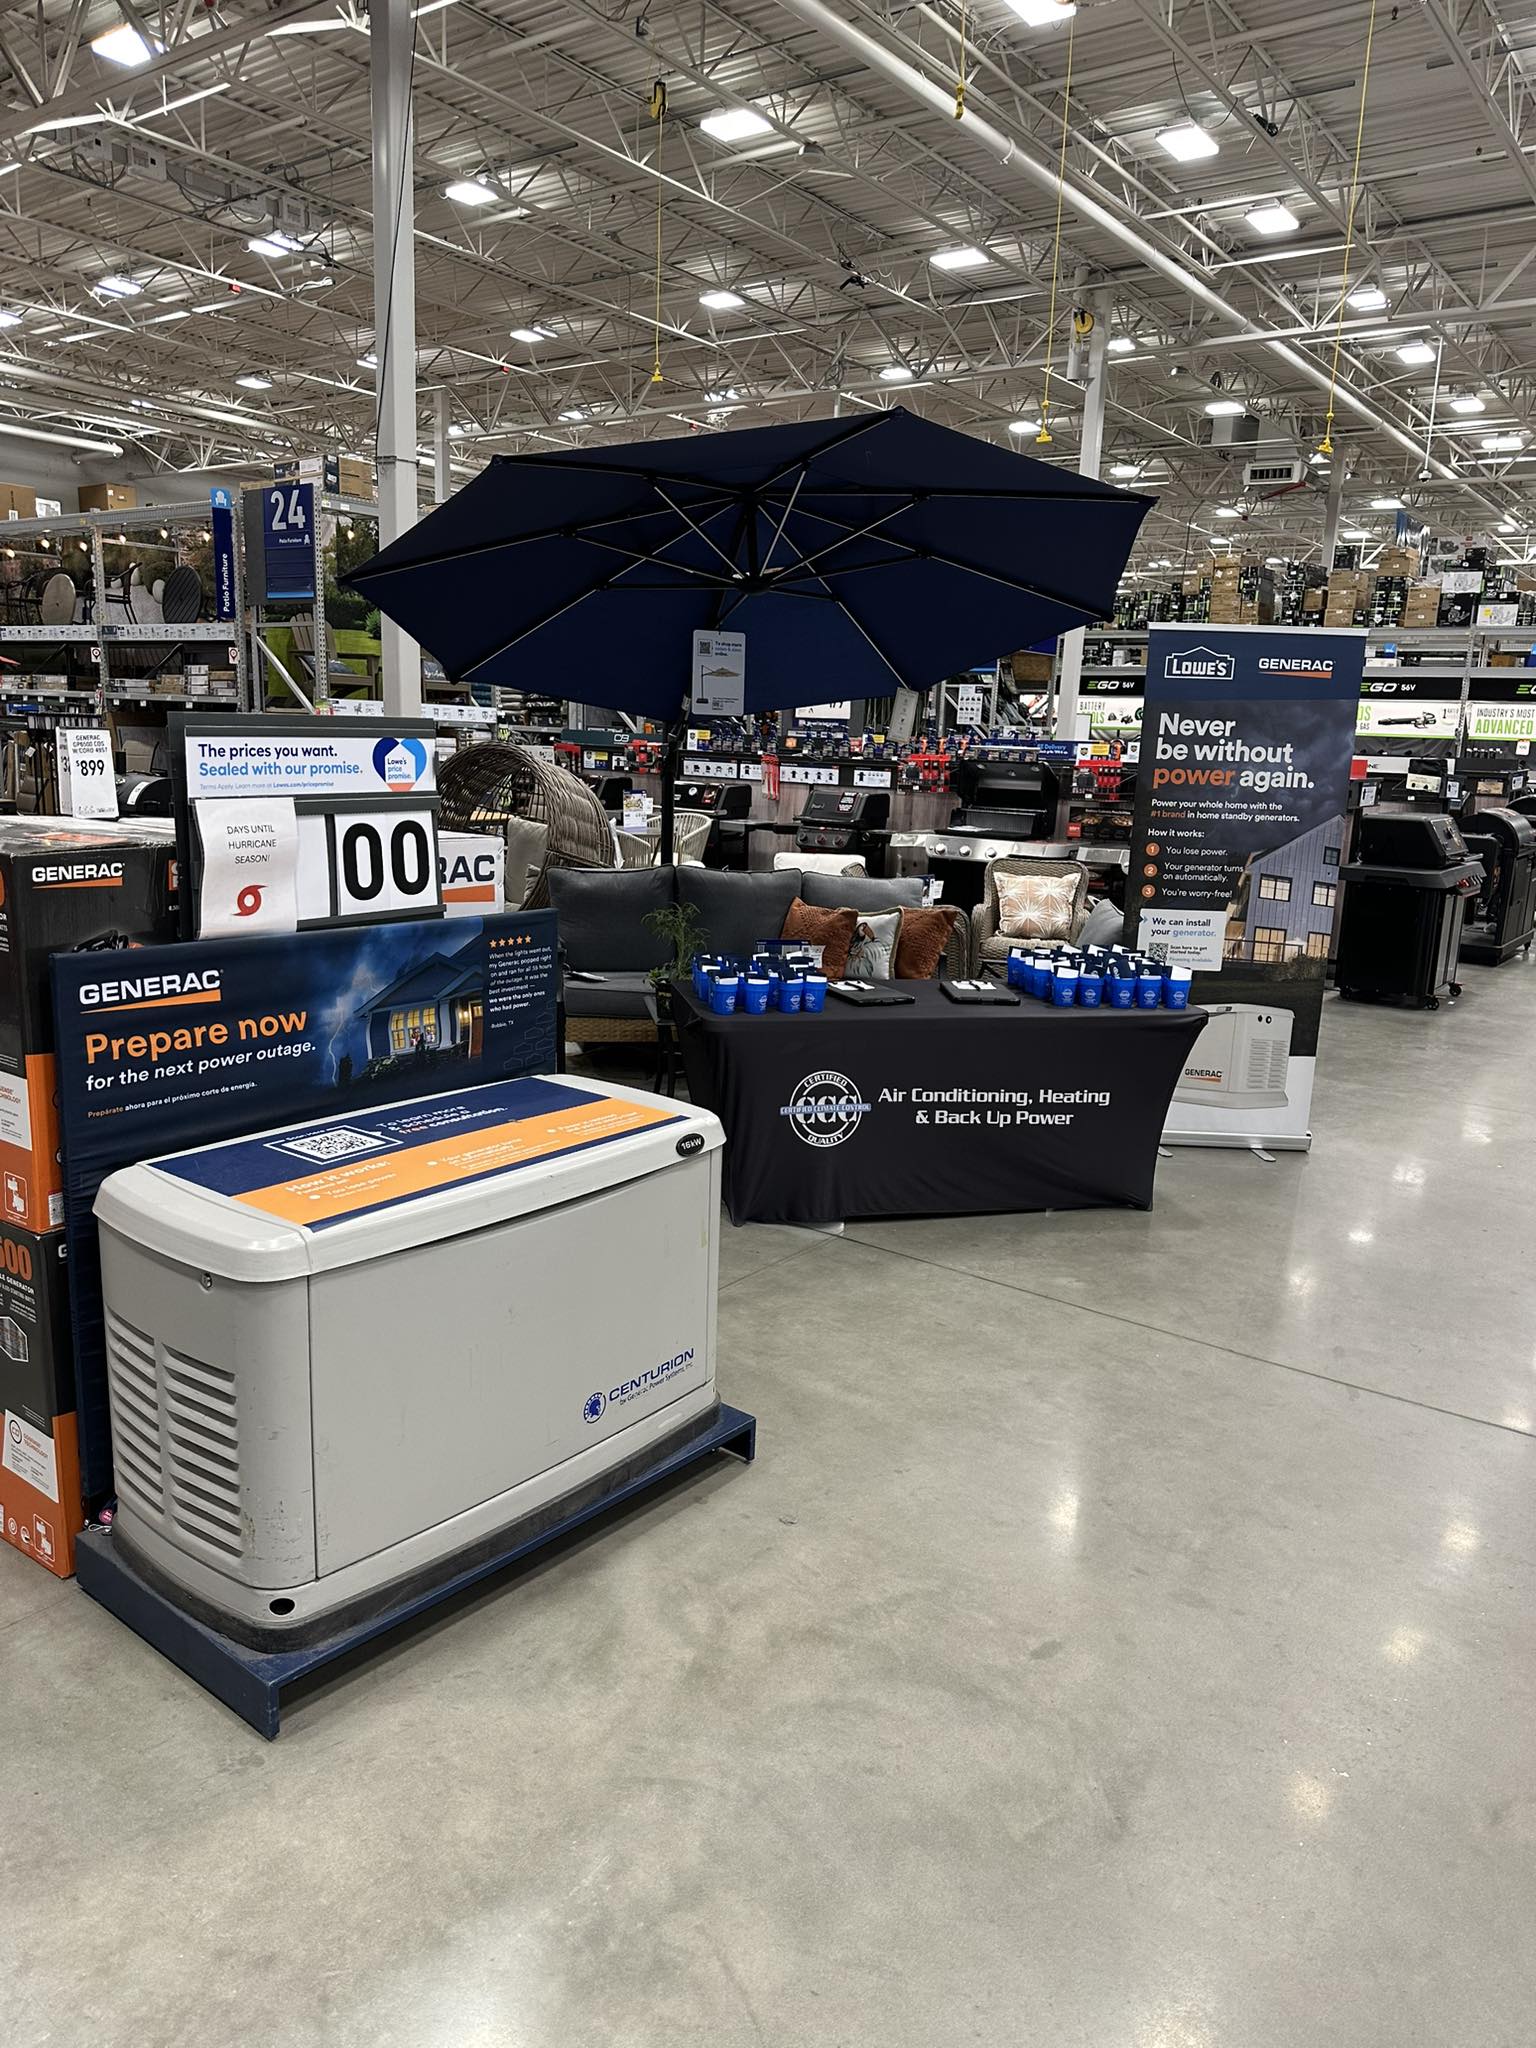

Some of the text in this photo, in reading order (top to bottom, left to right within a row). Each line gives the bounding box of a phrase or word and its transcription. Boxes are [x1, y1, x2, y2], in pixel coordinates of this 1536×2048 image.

[270, 489, 306, 531] 24
[222, 553, 231, 612] Patio Furniture
[1172, 659, 1228, 676] LOWE'S
[1258, 657, 1334, 671] GENERAC
[1087, 681, 1120, 690] EGO
[1360, 682, 1397, 692] EGO
[1080, 702, 1106, 710] BATTERY
[1476, 708, 1536, 718] INDUSTRY'S MOST
[1159, 712, 1236, 737] Never
[1475, 719, 1534, 735] ADVANCED
[198, 743, 338, 760] The prices you want.
[1156, 738, 1294, 764] be without
[76, 760, 104, 776] $899
[200, 761, 363, 776] Sealed with our promise.
[1152, 766, 1315, 792] power again.
[1152, 799, 1283, 811] Power your whole home with the
[1161, 810, 1186, 819] brand
[1187, 810, 1194, 819] in
[1196, 811, 1219, 820] home
[1221, 812, 1253, 822] standby
[1254, 813, 1300, 823] generators.
[226, 824, 274, 835] DAYS UNTIL
[1148, 828, 1204, 838] How it works:
[228, 839, 277, 850] HURRICANE
[234, 854, 270, 864] SEASON!
[1166, 846, 1181, 855] You
[1182, 847, 1199, 856] lose
[1200, 848, 1228, 858] power.
[342, 820, 430, 901] 00
[32, 863, 123, 882] GENERAC
[1164, 862, 1182, 872] Your
[1184, 864, 1222, 874] generator
[1224, 864, 1244, 872] turns
[1162, 872, 1228, 884] on automatically.
[1162, 888, 1188, 898] You're
[1190, 889, 1232, 900] worry-free!
[1152, 918, 1166, 926] We
[1186, 918, 1211, 926] install
[1151, 928, 1216, 938] your generator.
[521, 956, 540, 964] popped
[540, 954, 552, 962] right
[79, 970, 221, 1005] GENERAC
[501, 984, 528, 993] investment
[85, 1010, 308, 1064] Prepare now
[86, 1040, 317, 1091] for the next power outage.
[1185, 1068, 1222, 1078] GENERAC
[804, 1074, 848, 1088] CERTIFIED
[88, 1106, 124, 1118] Prepárate
[125, 1101, 146, 1112] ahora
[146, 1098, 163, 1108] para
[164, 1096, 171, 1104] el
[172, 1090, 200, 1104] próximo
[201, 1087, 219, 1098] corte
[230, 1080, 258, 1093] energía.
[878, 1088, 1110, 1106] Air Conditioning, Heating
[396, 1113, 432, 1123] learn
[432, 1106, 465, 1115] more
[796, 1095, 856, 1124] CCC
[402, 1112, 460, 1128] schedule
[916, 1110, 1074, 1128] & Back Up Power
[398, 1126, 429, 1134] free
[680, 1136, 702, 1150] 16kW
[808, 1132, 844, 1144] QUALITY
[286, 1179, 324, 1192] How
[340, 1161, 392, 1177] works:
[608, 1348, 694, 1402] CENTURION
